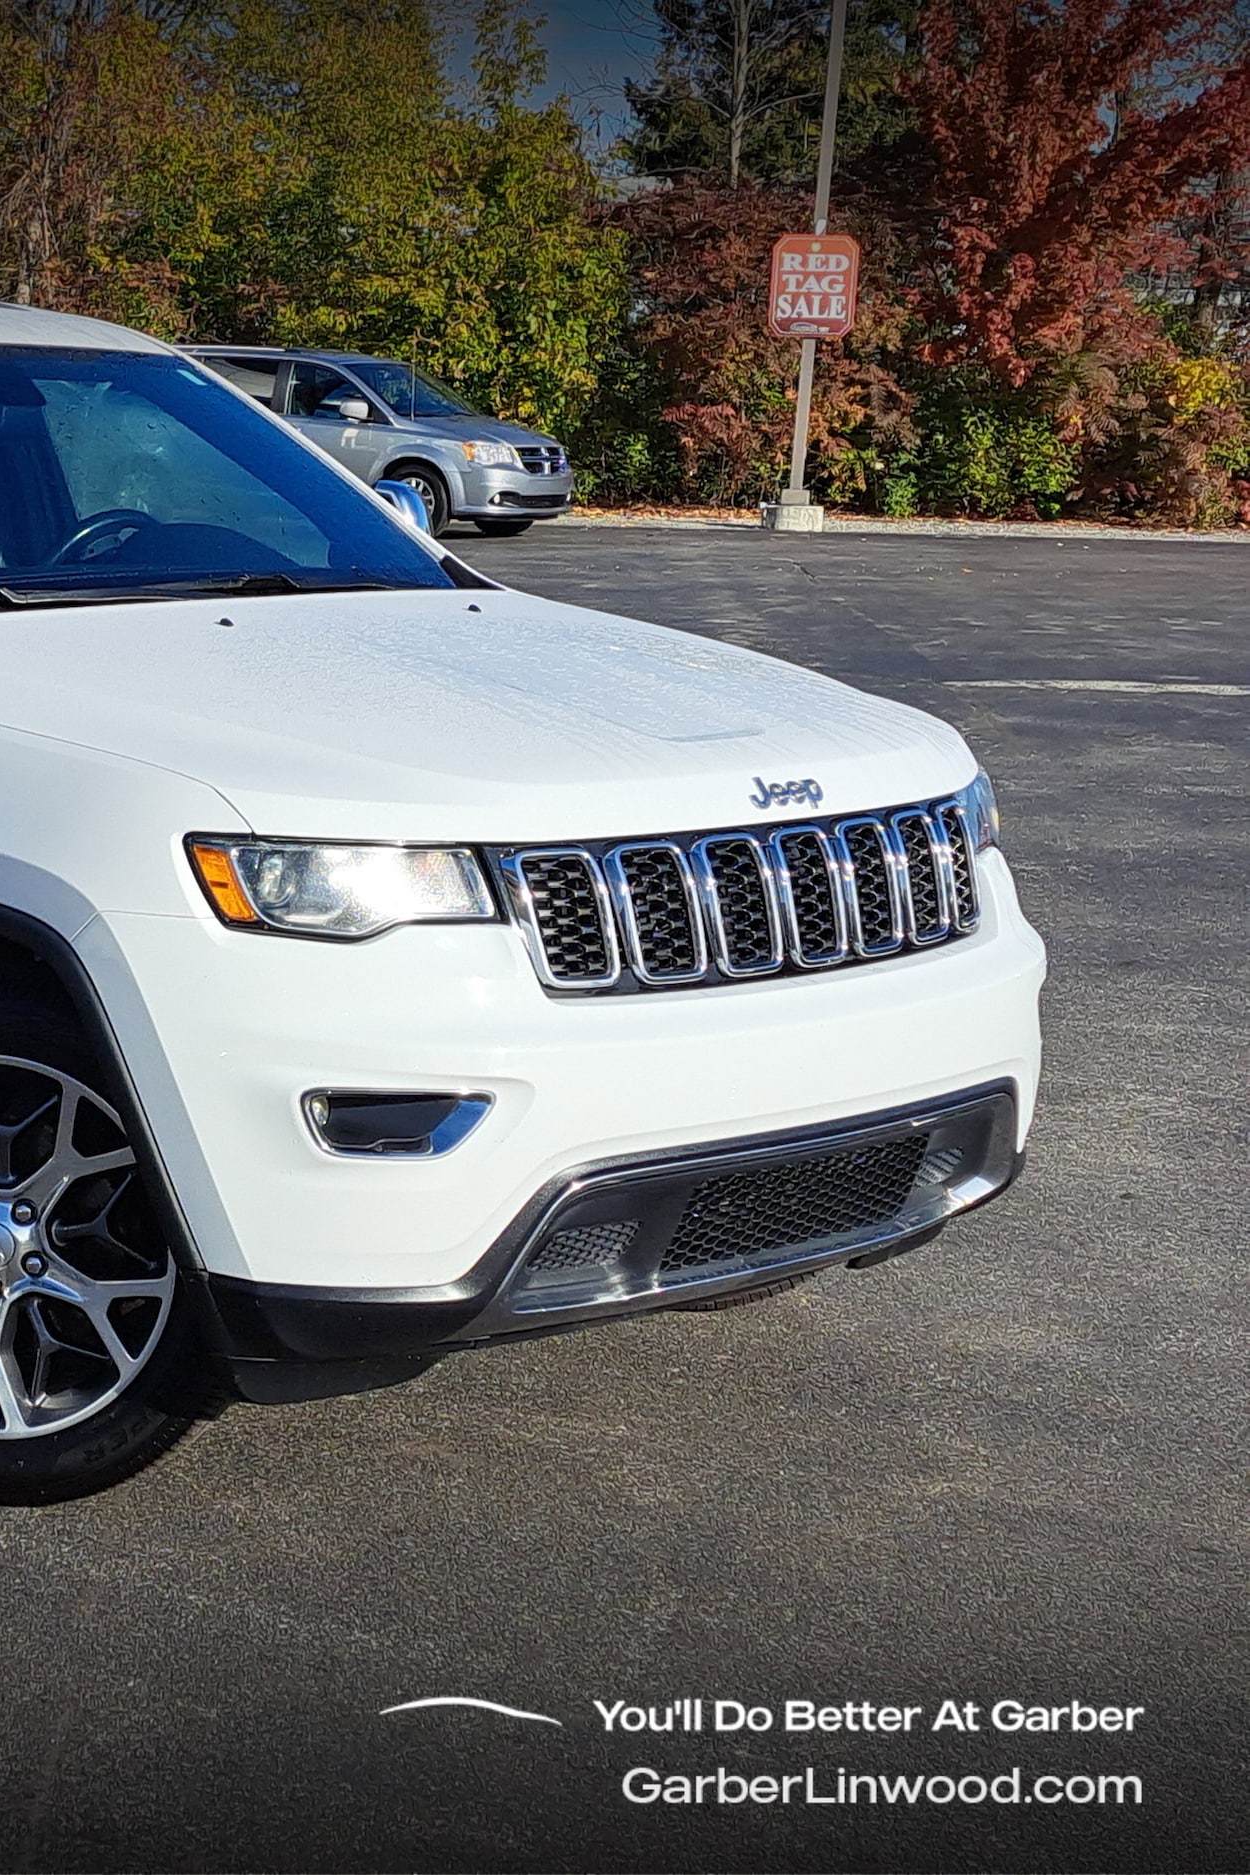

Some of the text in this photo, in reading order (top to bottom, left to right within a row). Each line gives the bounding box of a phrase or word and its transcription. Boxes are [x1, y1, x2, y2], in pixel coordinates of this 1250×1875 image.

[780, 252, 850, 272] RED
[781, 273, 846, 294] TAG
[776, 293, 847, 319] SALE
[748, 775, 824, 811] Jeep
